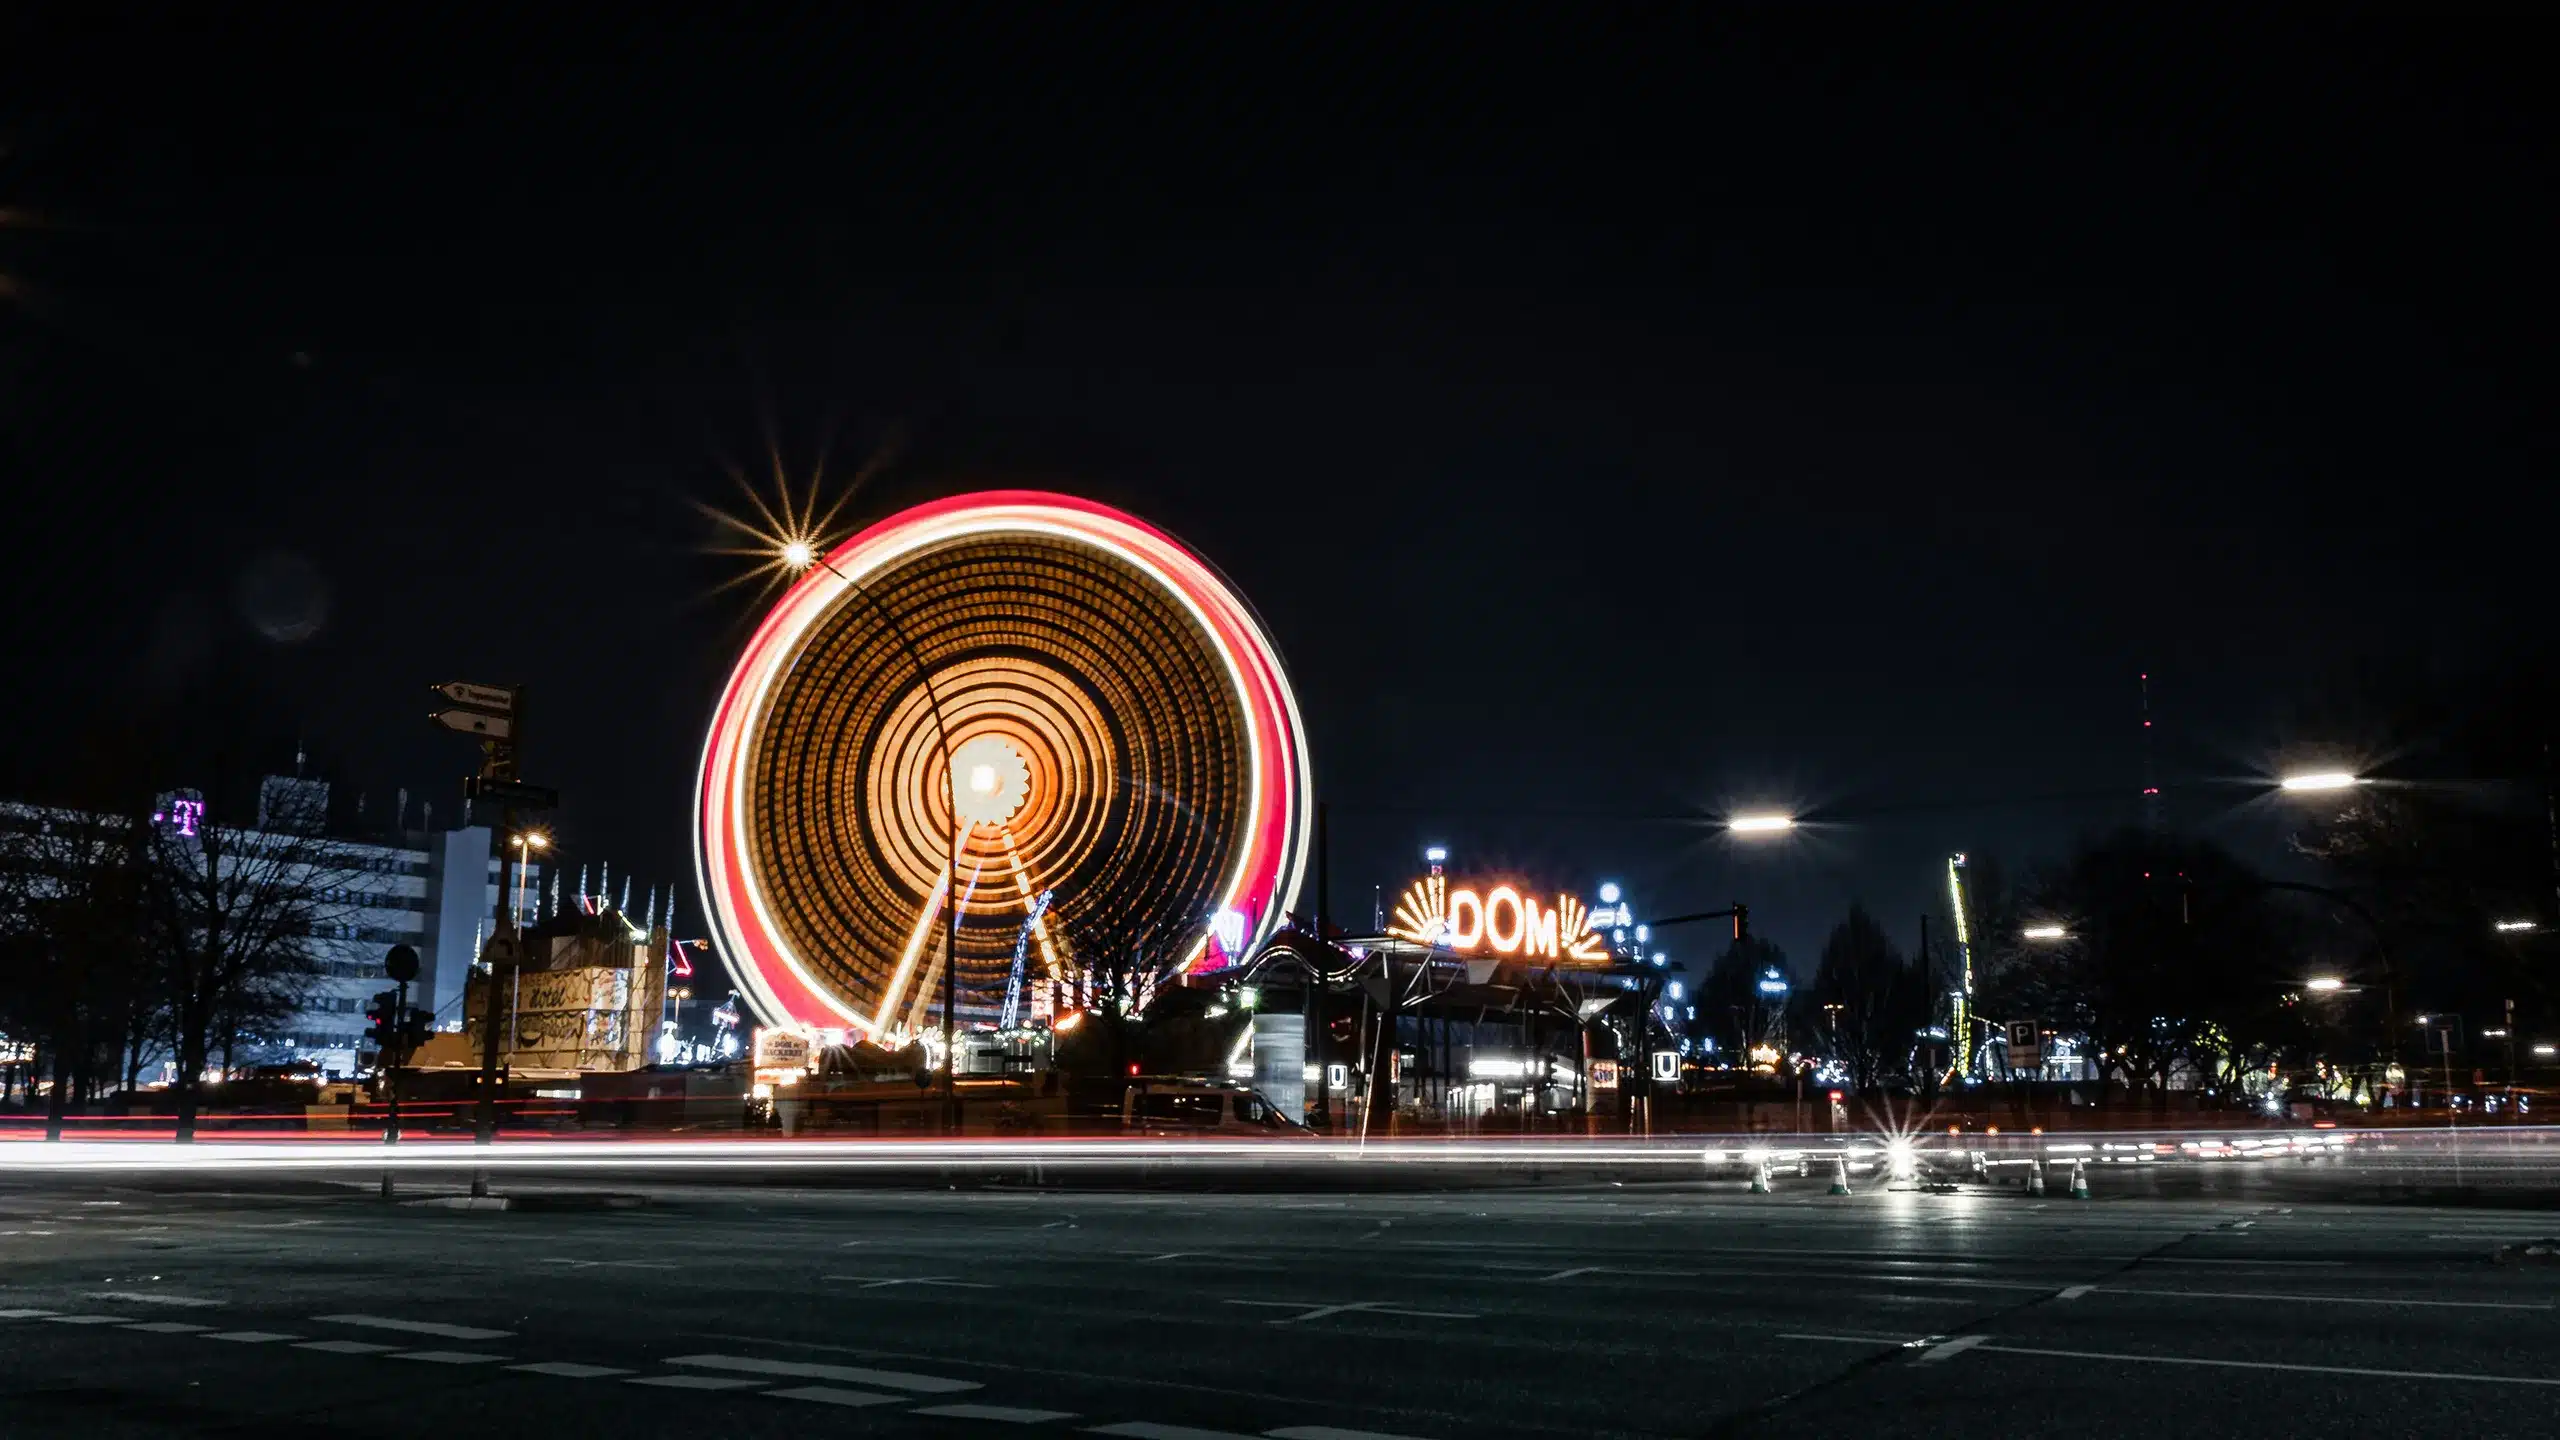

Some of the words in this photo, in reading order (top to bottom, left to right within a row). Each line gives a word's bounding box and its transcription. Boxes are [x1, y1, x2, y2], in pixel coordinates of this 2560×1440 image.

[173, 800, 203, 836] T
[1450, 885, 1558, 958] DOM
[2016, 1025, 2029, 1044] P
[1331, 1066, 1345, 1088] U
[1657, 1054, 1676, 1079] U
